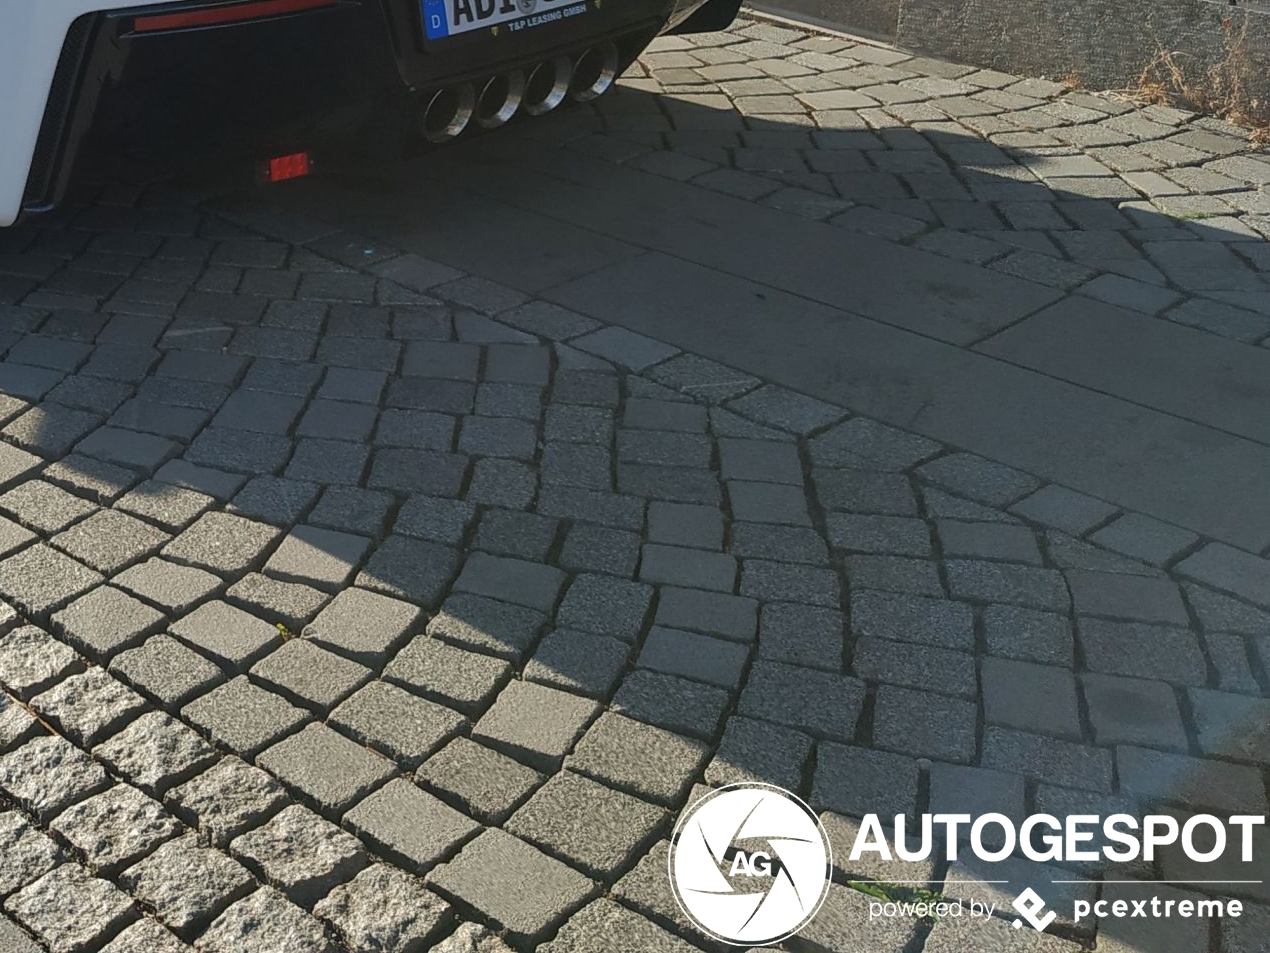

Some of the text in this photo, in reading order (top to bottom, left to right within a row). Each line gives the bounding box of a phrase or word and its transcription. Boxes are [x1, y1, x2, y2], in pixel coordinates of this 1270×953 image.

[431, 14, 441, 30] D
[508, 19, 526, 32] T&P
[527, 10, 562, 28] LEASING
